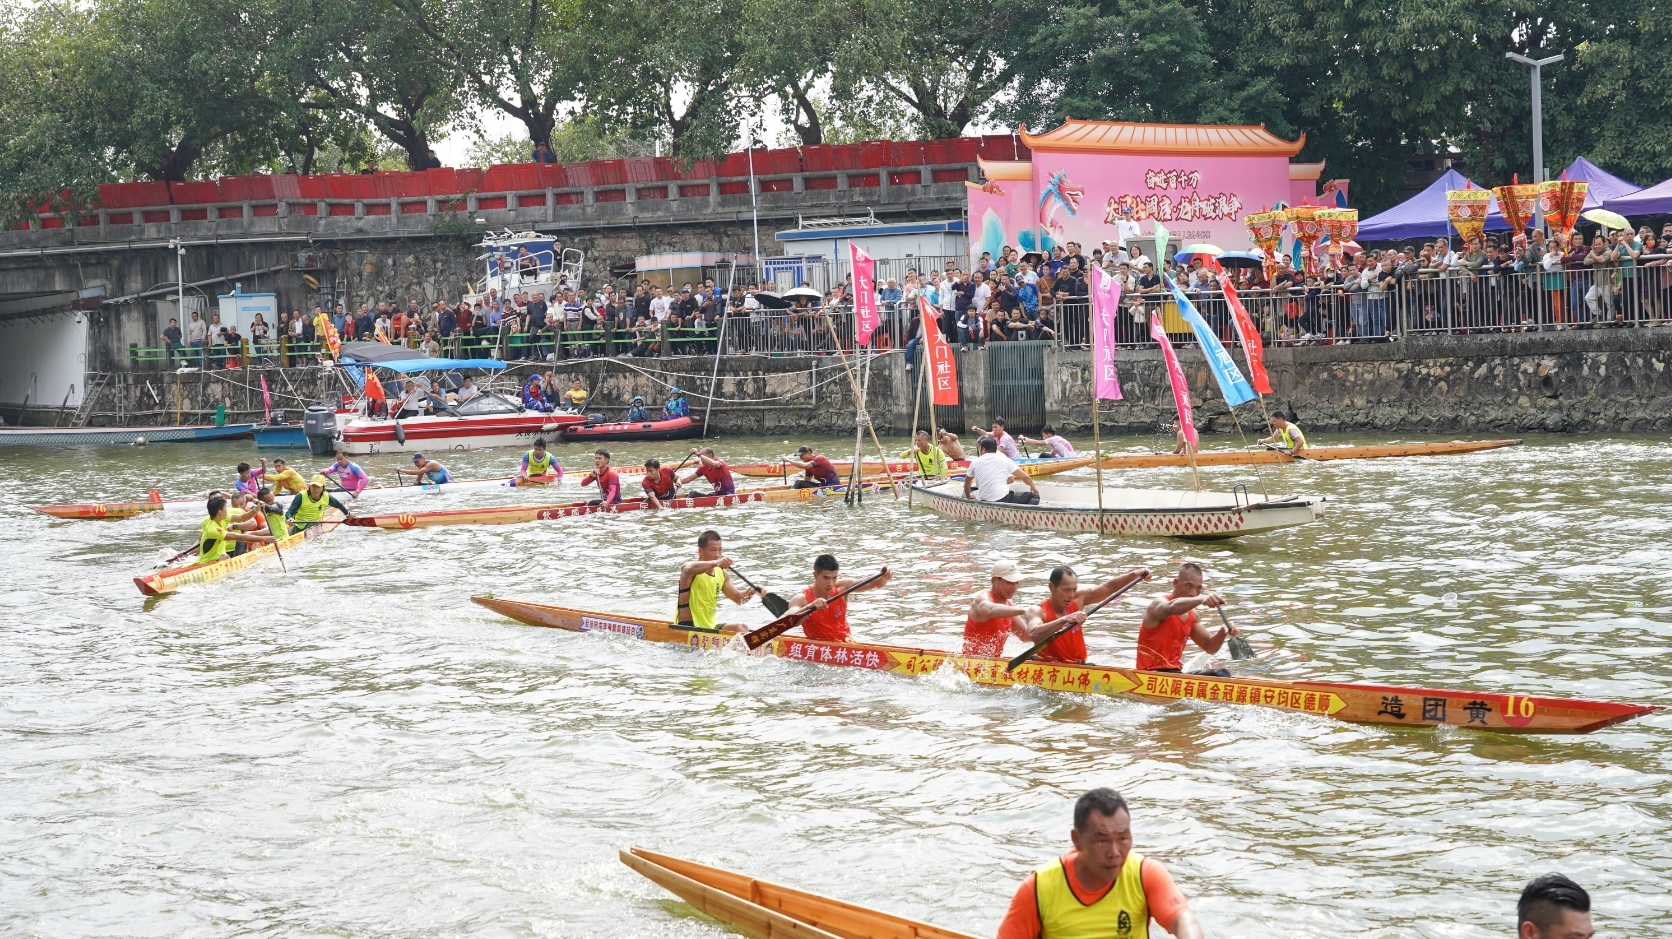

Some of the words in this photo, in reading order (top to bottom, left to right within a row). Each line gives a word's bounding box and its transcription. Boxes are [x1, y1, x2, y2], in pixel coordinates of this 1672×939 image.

[859, 276, 873, 333] 大门社区
[933, 333, 952, 391] 大门社区
[769, 465, 781, 473] 71
[93, 504, 107, 513] 76
[1503, 695, 1535, 718] 16
